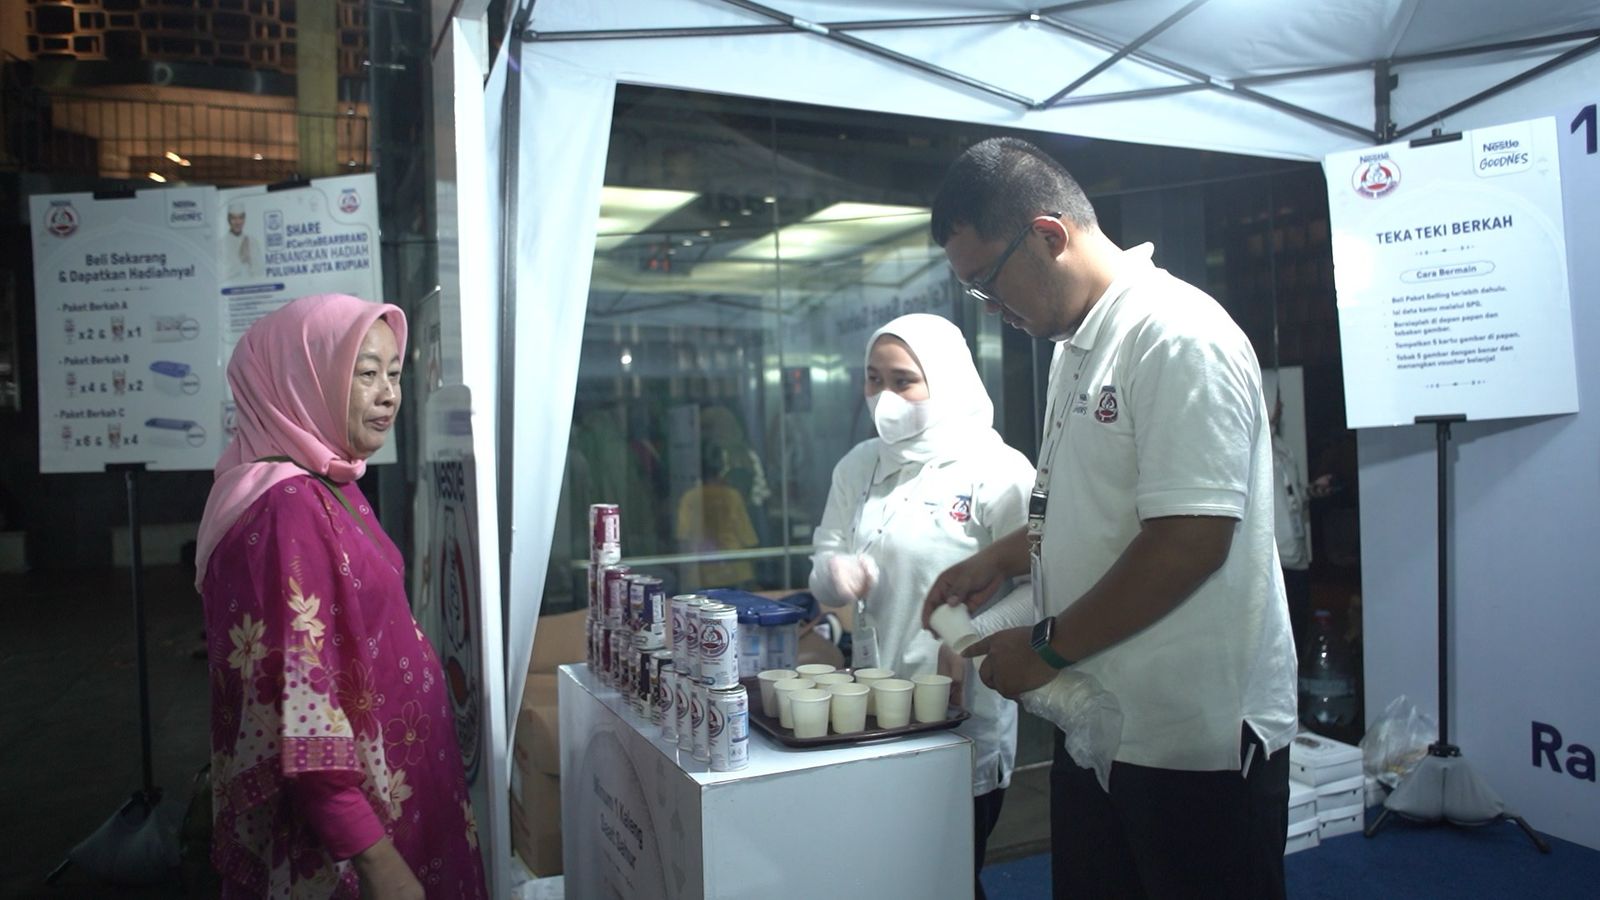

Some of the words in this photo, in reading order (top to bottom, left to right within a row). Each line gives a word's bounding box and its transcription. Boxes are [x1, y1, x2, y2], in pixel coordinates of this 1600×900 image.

[1480, 152, 1528, 170] GOODNES
[286, 222, 321, 237] SHARE
[1376, 229, 1412, 244] TEKA
[1415, 224, 1447, 240] TEKI
[1452, 215, 1513, 235] BERKAH
[86, 254, 108, 266] Beli
[111, 252, 166, 266] Sekarang
[265, 247, 328, 265] MENANGKAN
[331, 244, 369, 258] HADIAH
[70, 268, 127, 284] Dapatkan
[129, 265, 195, 280] Hadiahnya!
[265, 264, 308, 277] PULUHAN
[310, 261, 333, 274] JUTA
[335, 258, 369, 271] RUPIAH
[1416, 269, 1437, 280] Cara
[1439, 265, 1477, 277] Bermain
[63, 302, 87, 312] Paket
[122, 300, 128, 310] A
[64, 355, 88, 365] Paket
[60, 409, 84, 419] Paket
[119, 407, 125, 418] C
[1531, 720, 1596, 783] Ra
